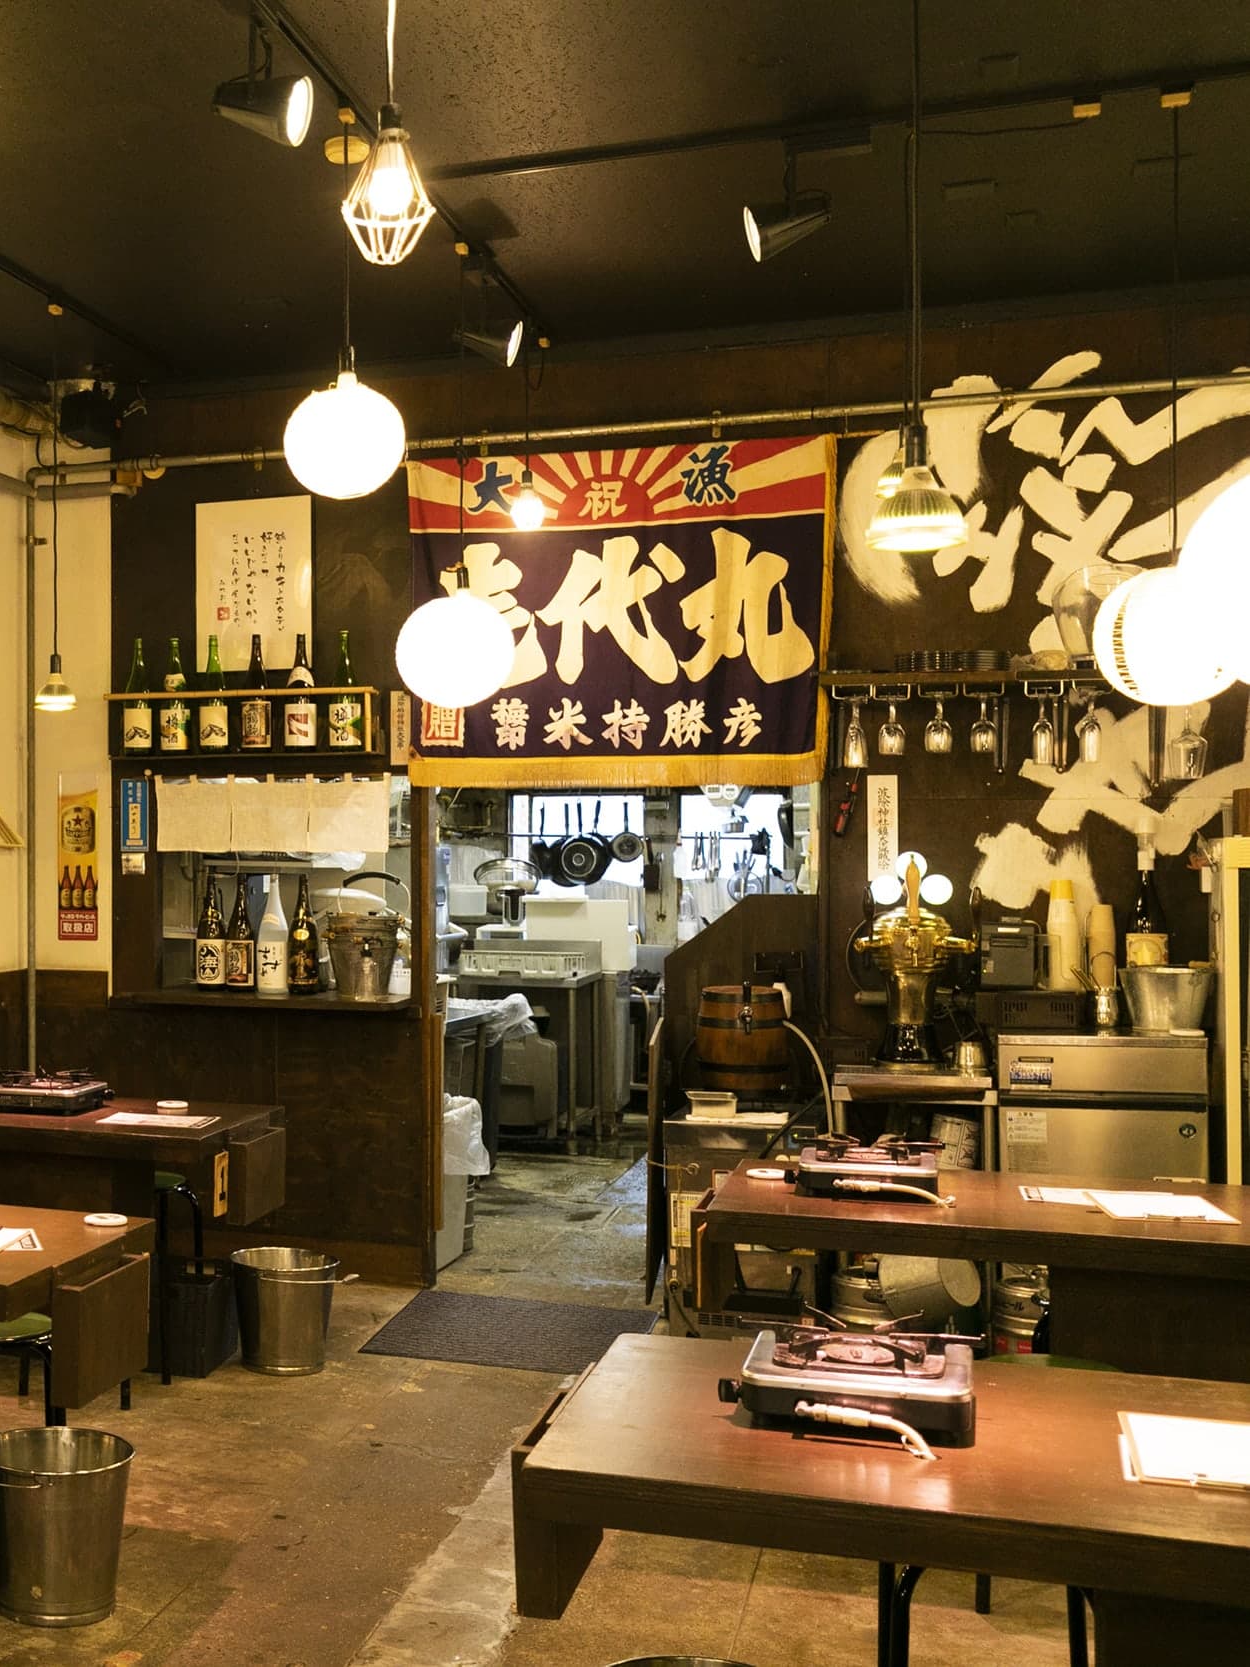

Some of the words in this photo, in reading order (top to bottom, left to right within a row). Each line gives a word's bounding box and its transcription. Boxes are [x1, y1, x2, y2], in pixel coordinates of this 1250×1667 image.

[468, 462, 516, 514] 大
[578, 480, 628, 521] 祝
[681, 445, 737, 507] 漁
